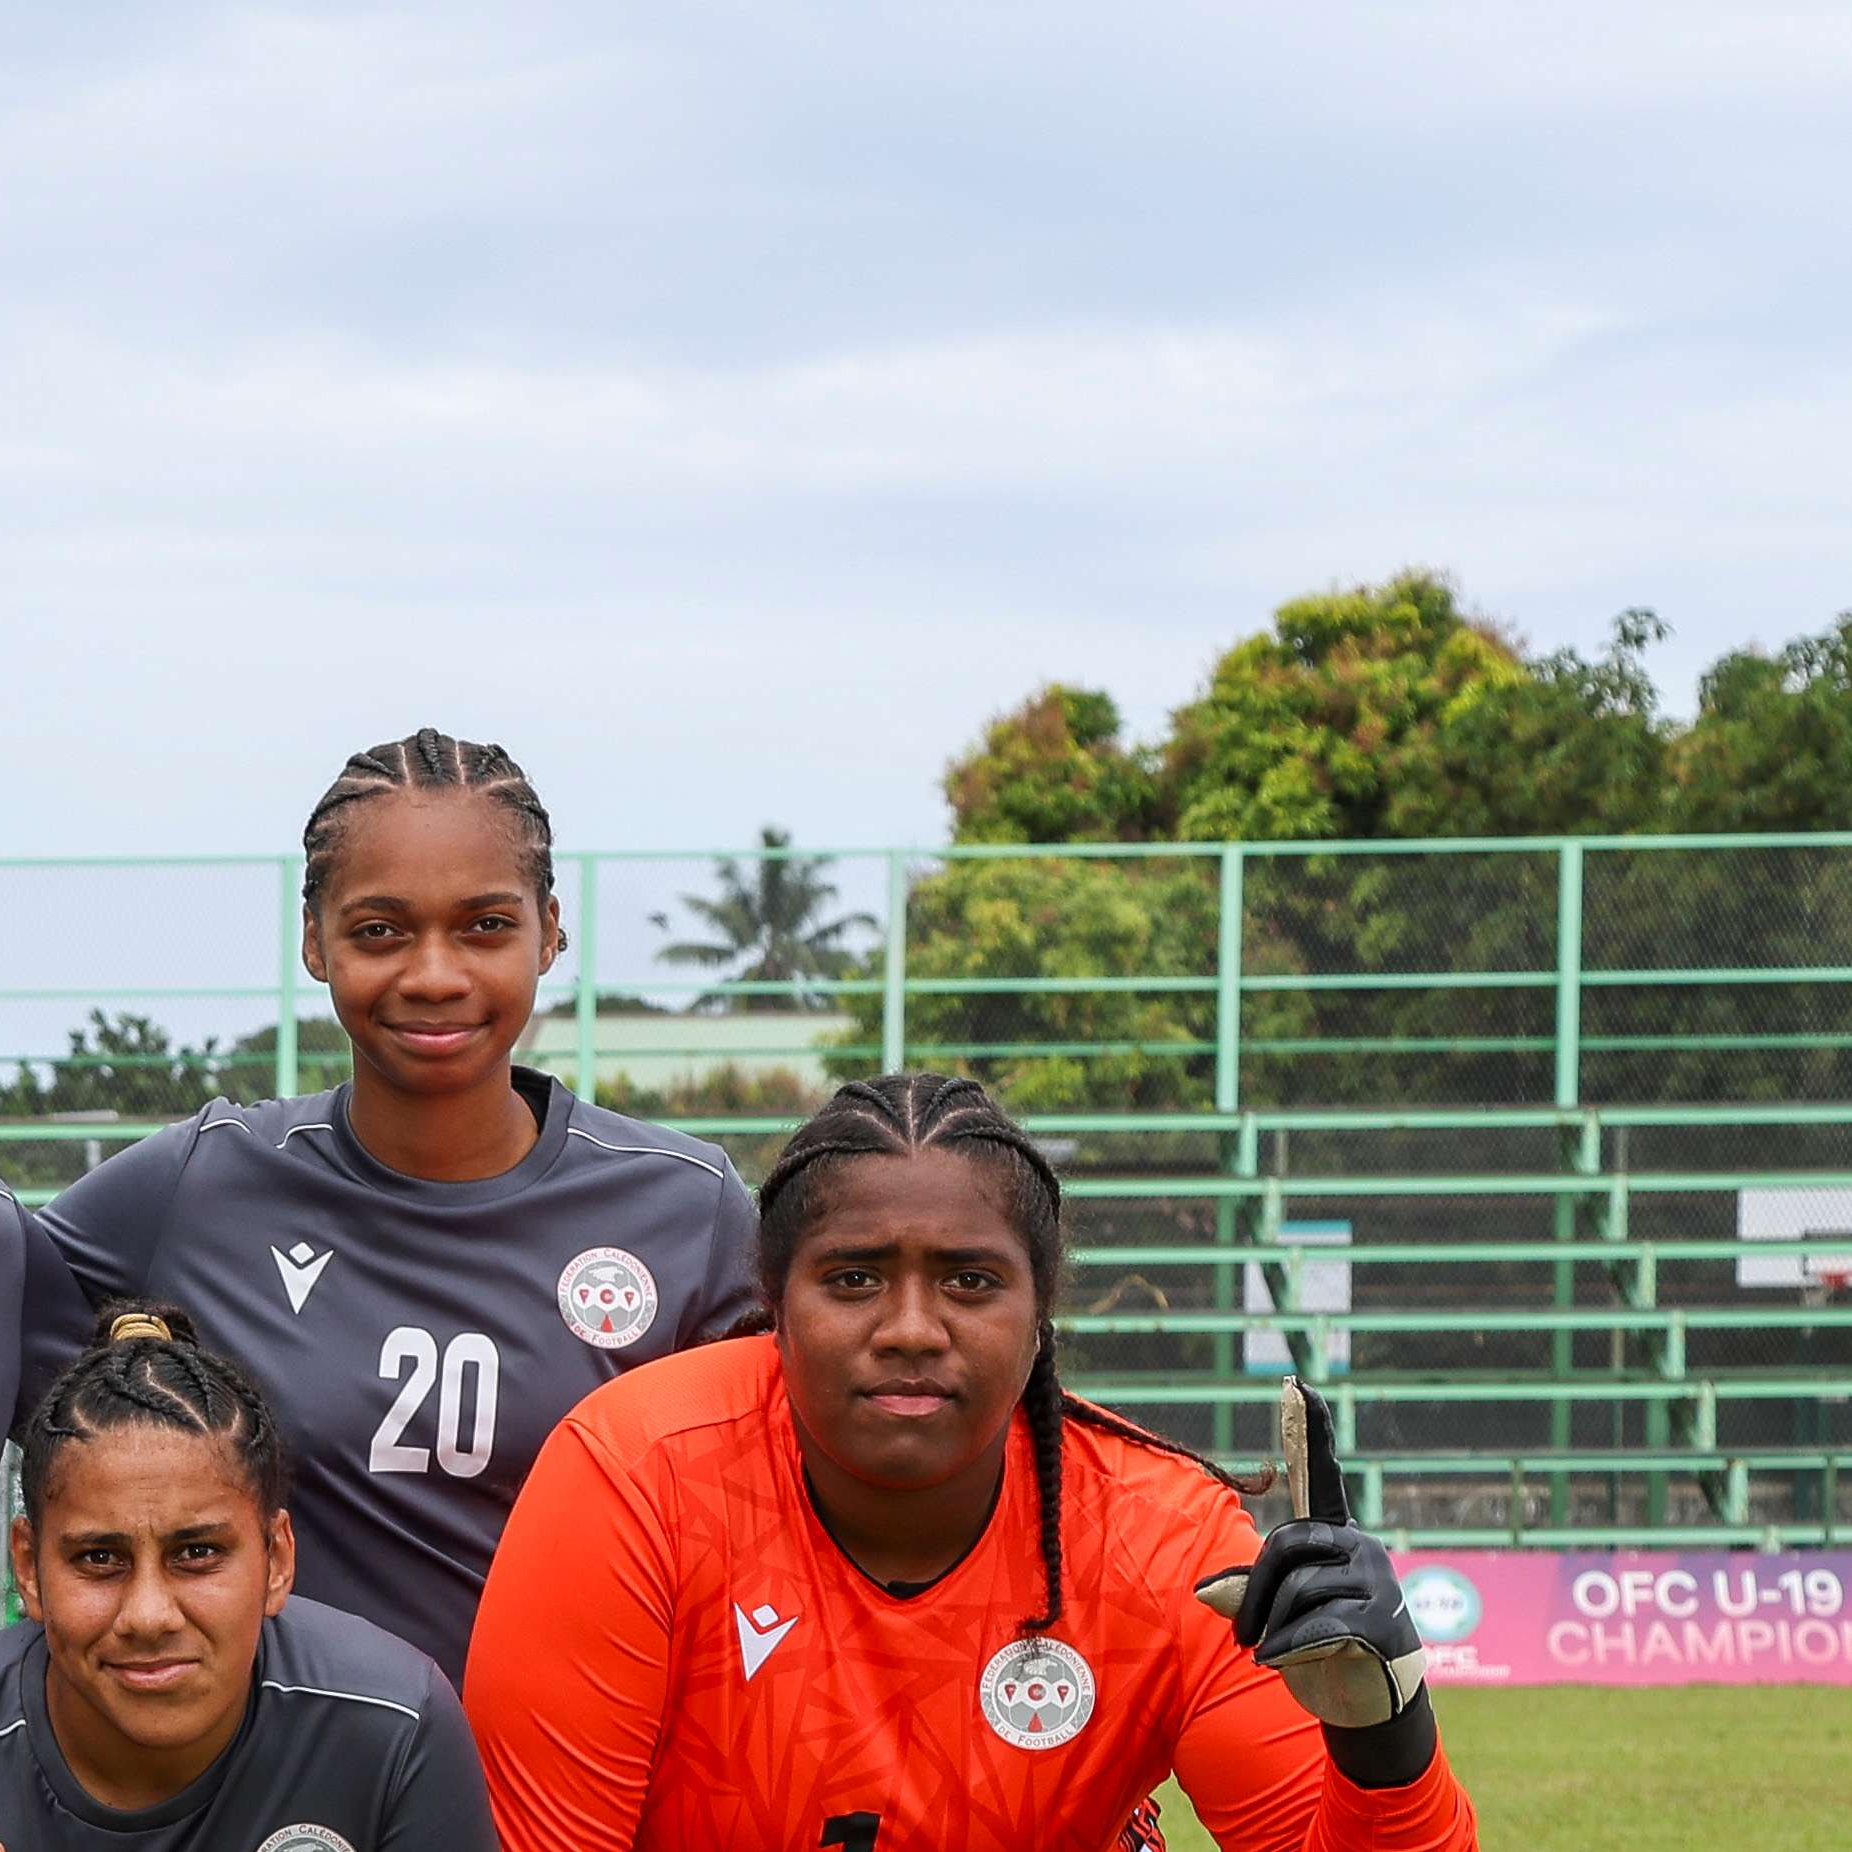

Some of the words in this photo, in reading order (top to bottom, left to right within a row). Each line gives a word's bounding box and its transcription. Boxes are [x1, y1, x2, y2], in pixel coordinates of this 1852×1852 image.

[369, 1326, 499, 1478] 20
[1572, 1570, 1699, 1618] OFC
[1713, 1568, 1843, 1618] U-19
[997, 1725, 1012, 1739] DE
